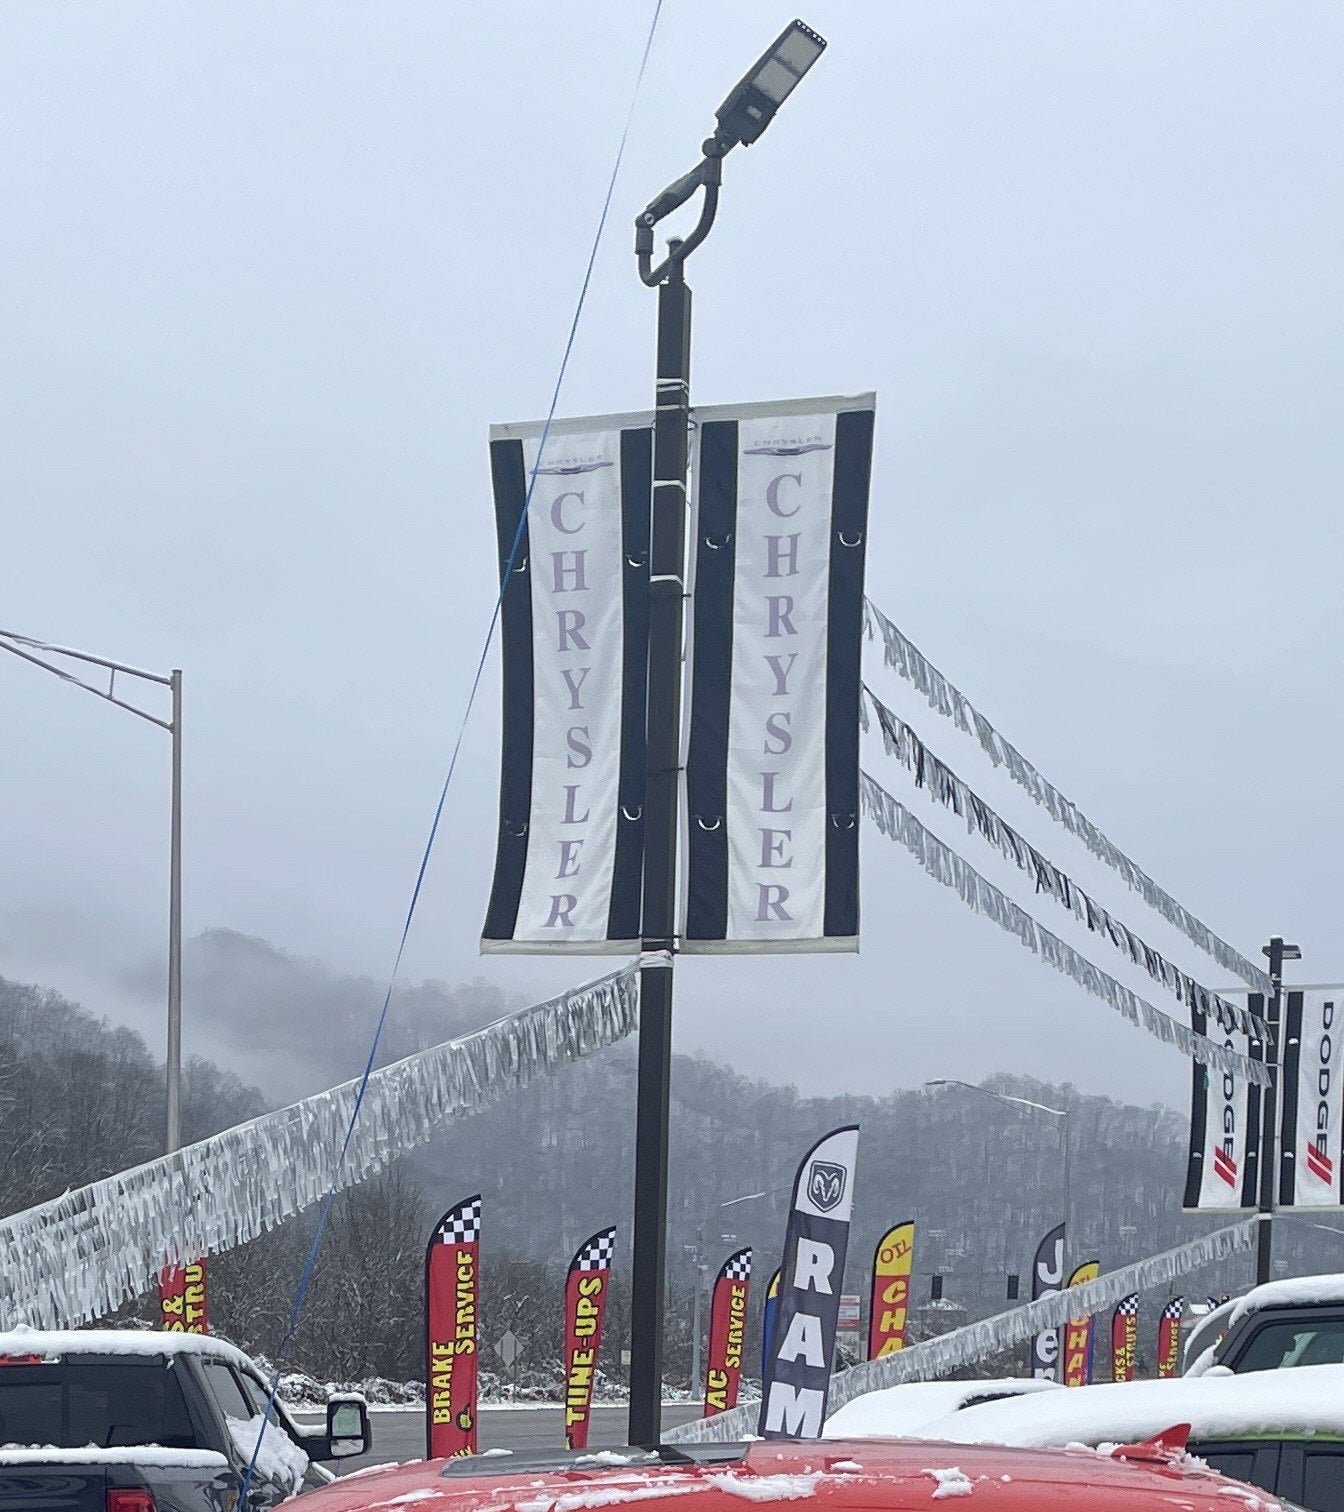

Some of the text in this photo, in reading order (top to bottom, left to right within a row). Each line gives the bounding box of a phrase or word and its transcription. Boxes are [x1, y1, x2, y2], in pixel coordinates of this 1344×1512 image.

[546, 491, 594, 929] CHRYSLER
[755, 472, 803, 923] CHRYSLER
[1316, 1001, 1334, 1160] DODGE
[455, 1250, 475, 1356] SERVICE
[880, 1239, 912, 1264] OIL
[566, 1277, 603, 1427] TUNE-UPS
[725, 1284, 746, 1369] SERVICE
[765, 1237, 835, 1438] RAM
[1125, 1317, 1136, 1367] STRUTS
[432, 1341, 455, 1425] BRAKE
[707, 1369, 729, 1410] AC
